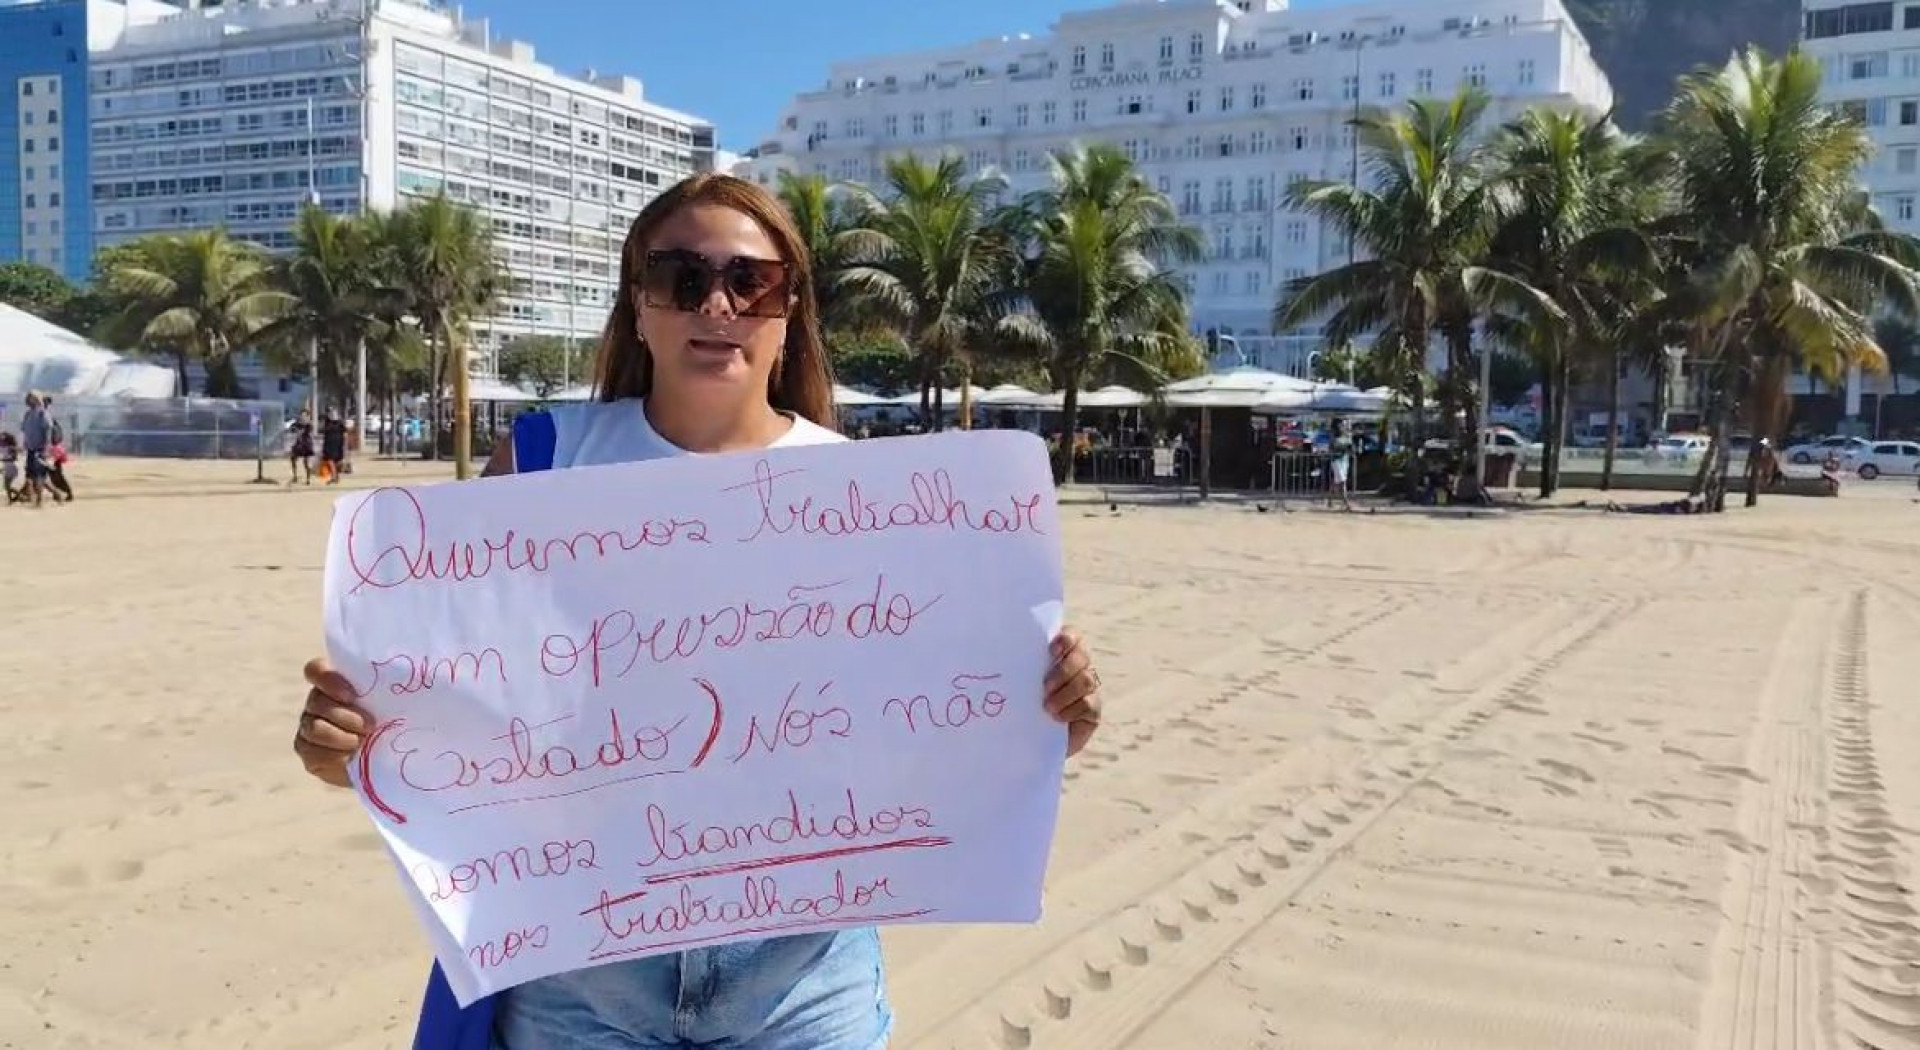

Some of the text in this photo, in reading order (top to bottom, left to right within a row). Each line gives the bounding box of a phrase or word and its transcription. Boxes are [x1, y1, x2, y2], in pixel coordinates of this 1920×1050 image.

[1070, 66, 1202, 90] COPACABANA PALACE
[350, 459, 1046, 593] Queremos trabalhar
[359, 648, 506, 697] sem
[846, 573, 944, 639] do
[882, 673, 1006, 734] não
[411, 789, 934, 902] somos bandidos
[469, 869, 898, 968] nos trabalhador
